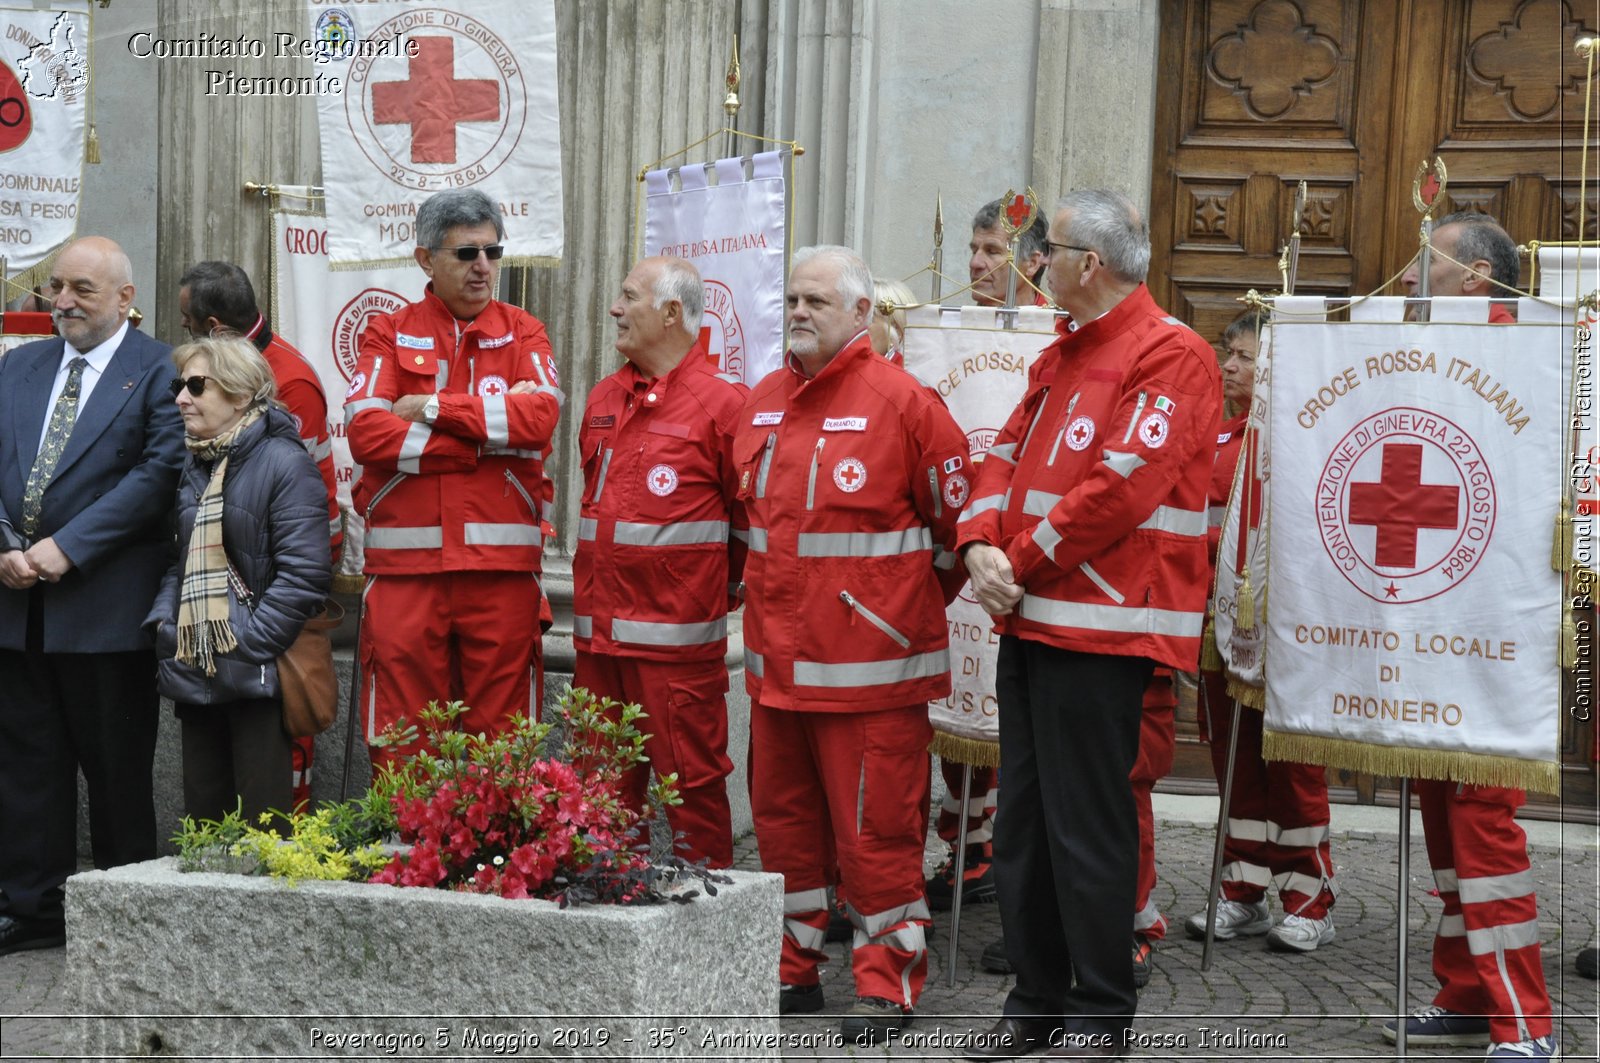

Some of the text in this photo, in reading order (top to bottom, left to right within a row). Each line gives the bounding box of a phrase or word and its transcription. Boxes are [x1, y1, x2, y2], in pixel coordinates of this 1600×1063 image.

[443, 13, 460, 28] DI
[464, 22, 517, 79] GINEVRA
[30, 202, 77, 219] PESIO
[364, 202, 421, 218] COMITA
[351, 305, 362, 319] DI
[963, 351, 1025, 378] ROSSA
[1297, 350, 1531, 436] CROCE ROSSA ITALIANA
[1320, 414, 1491, 580] CONVENZIONE DI GINEVRA 22 AGOSTO 1864
[1295, 623, 1516, 661] COMITATO LOCALE
[962, 655, 980, 677] DI
[1380, 665, 1400, 683] DI
[1333, 693, 1463, 726] DRONERO
